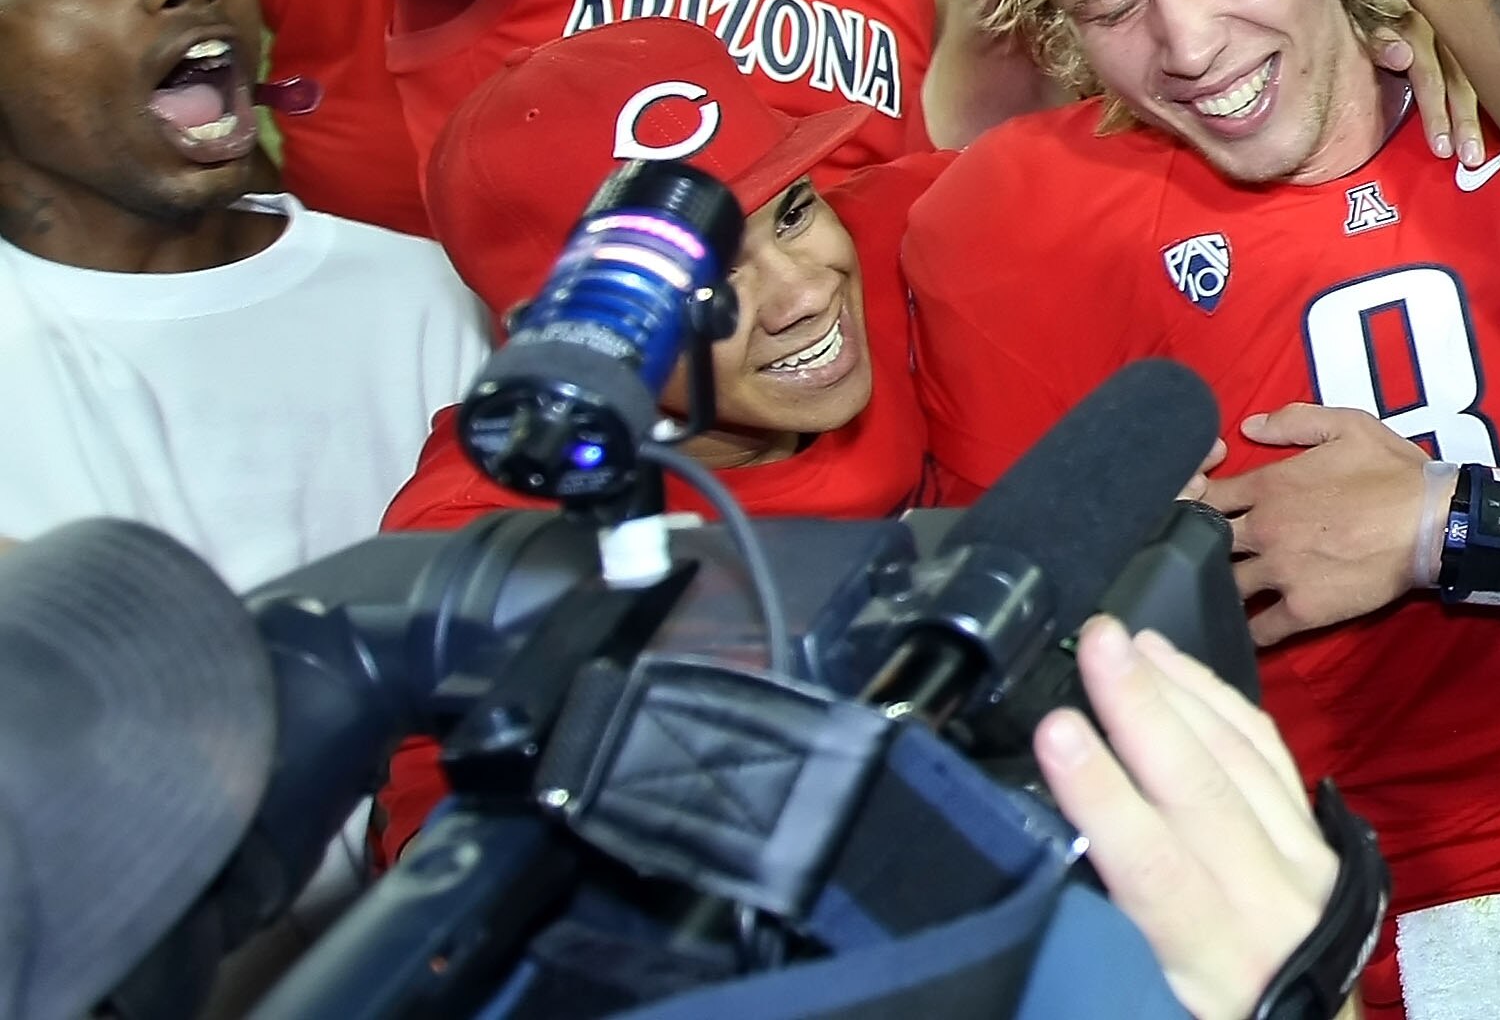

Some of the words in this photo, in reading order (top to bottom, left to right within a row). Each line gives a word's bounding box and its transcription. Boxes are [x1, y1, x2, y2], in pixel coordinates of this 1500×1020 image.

[613, 80, 721, 161] C
[1344, 181, 1400, 235] A
[1163, 233, 1230, 291] PAC
[1187, 267, 1226, 302] 10
